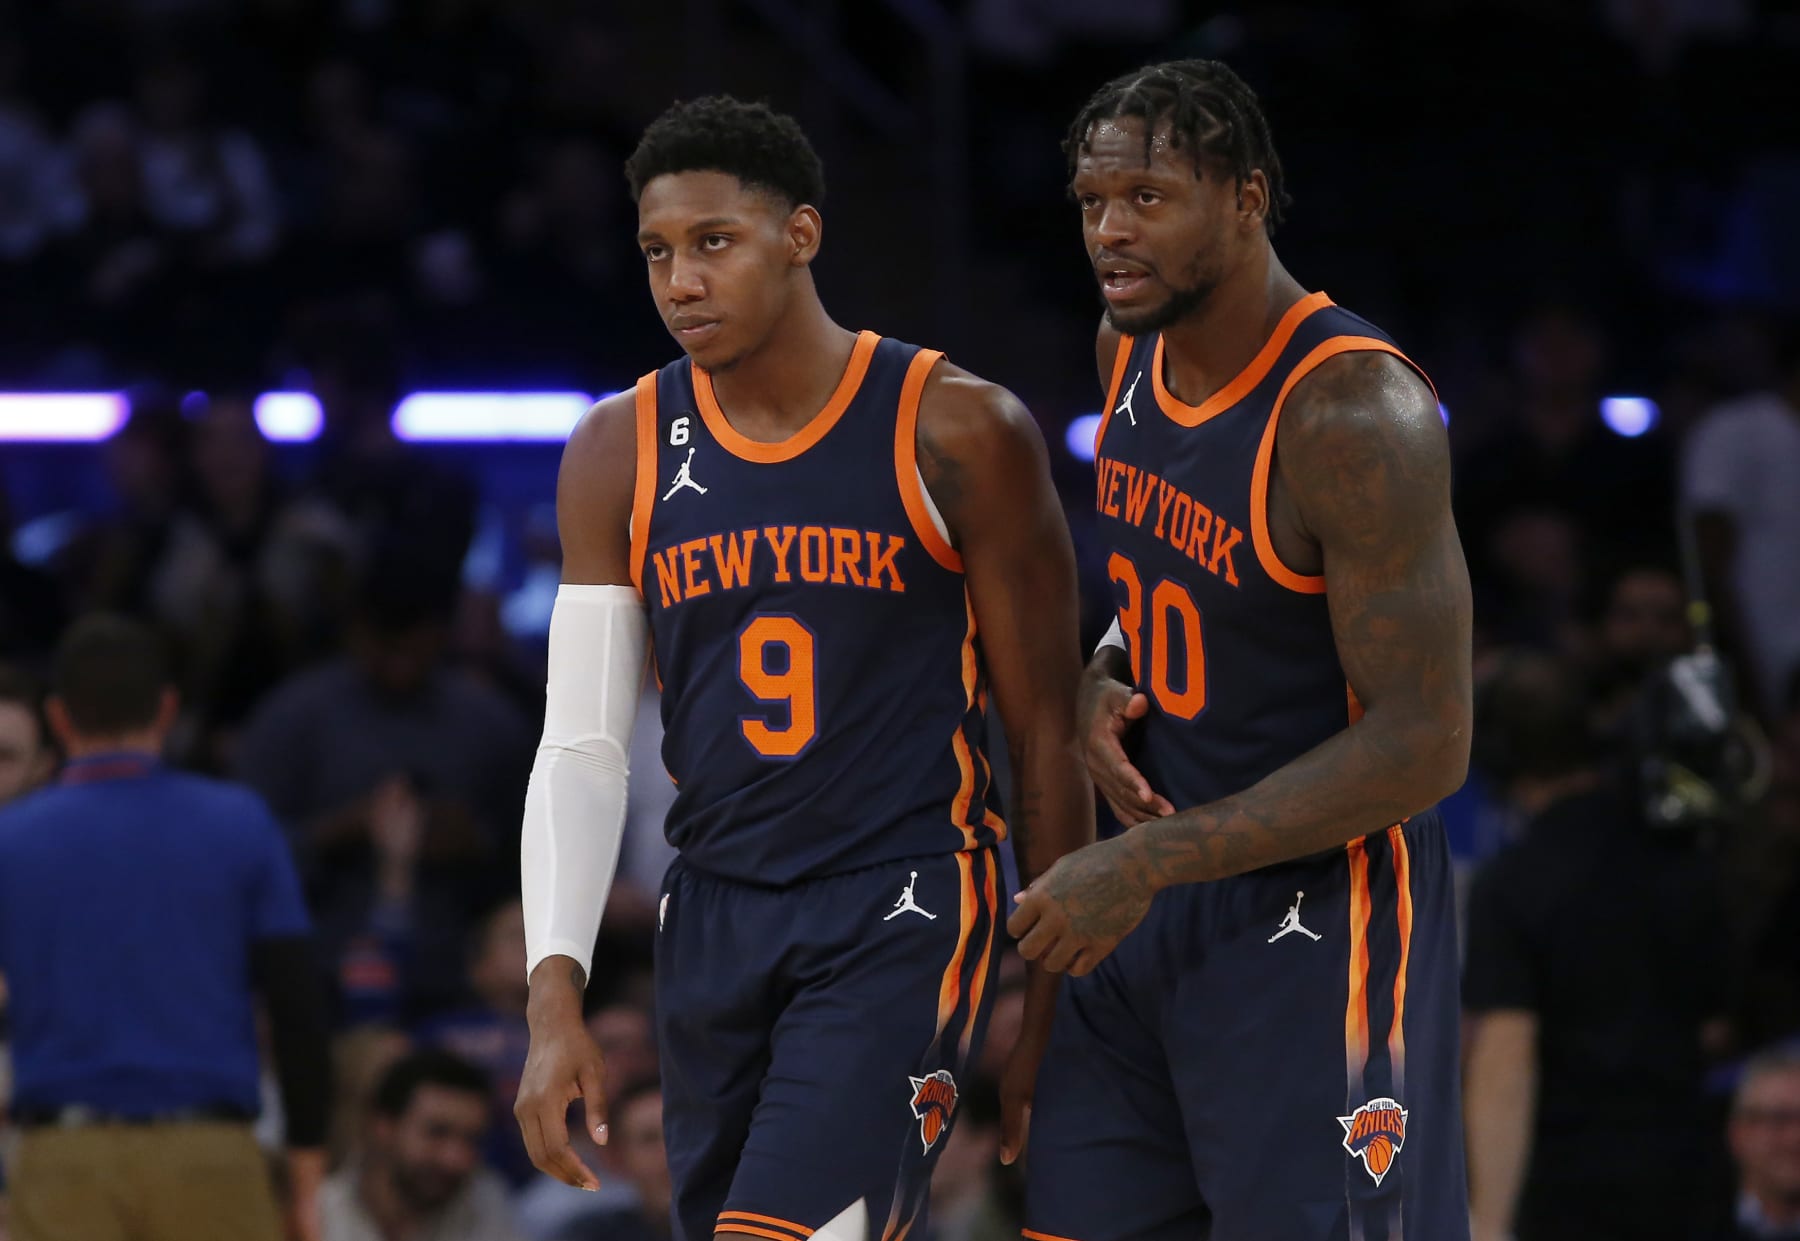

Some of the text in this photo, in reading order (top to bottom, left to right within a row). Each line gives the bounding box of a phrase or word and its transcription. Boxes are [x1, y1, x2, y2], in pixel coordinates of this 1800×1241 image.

[670, 417, 690, 446] 6
[653, 526, 905, 608] NEW YORK
[1154, 479, 1243, 588] YORK
[738, 615, 817, 757] 9
[1348, 1108, 1404, 1145] KNICKS
